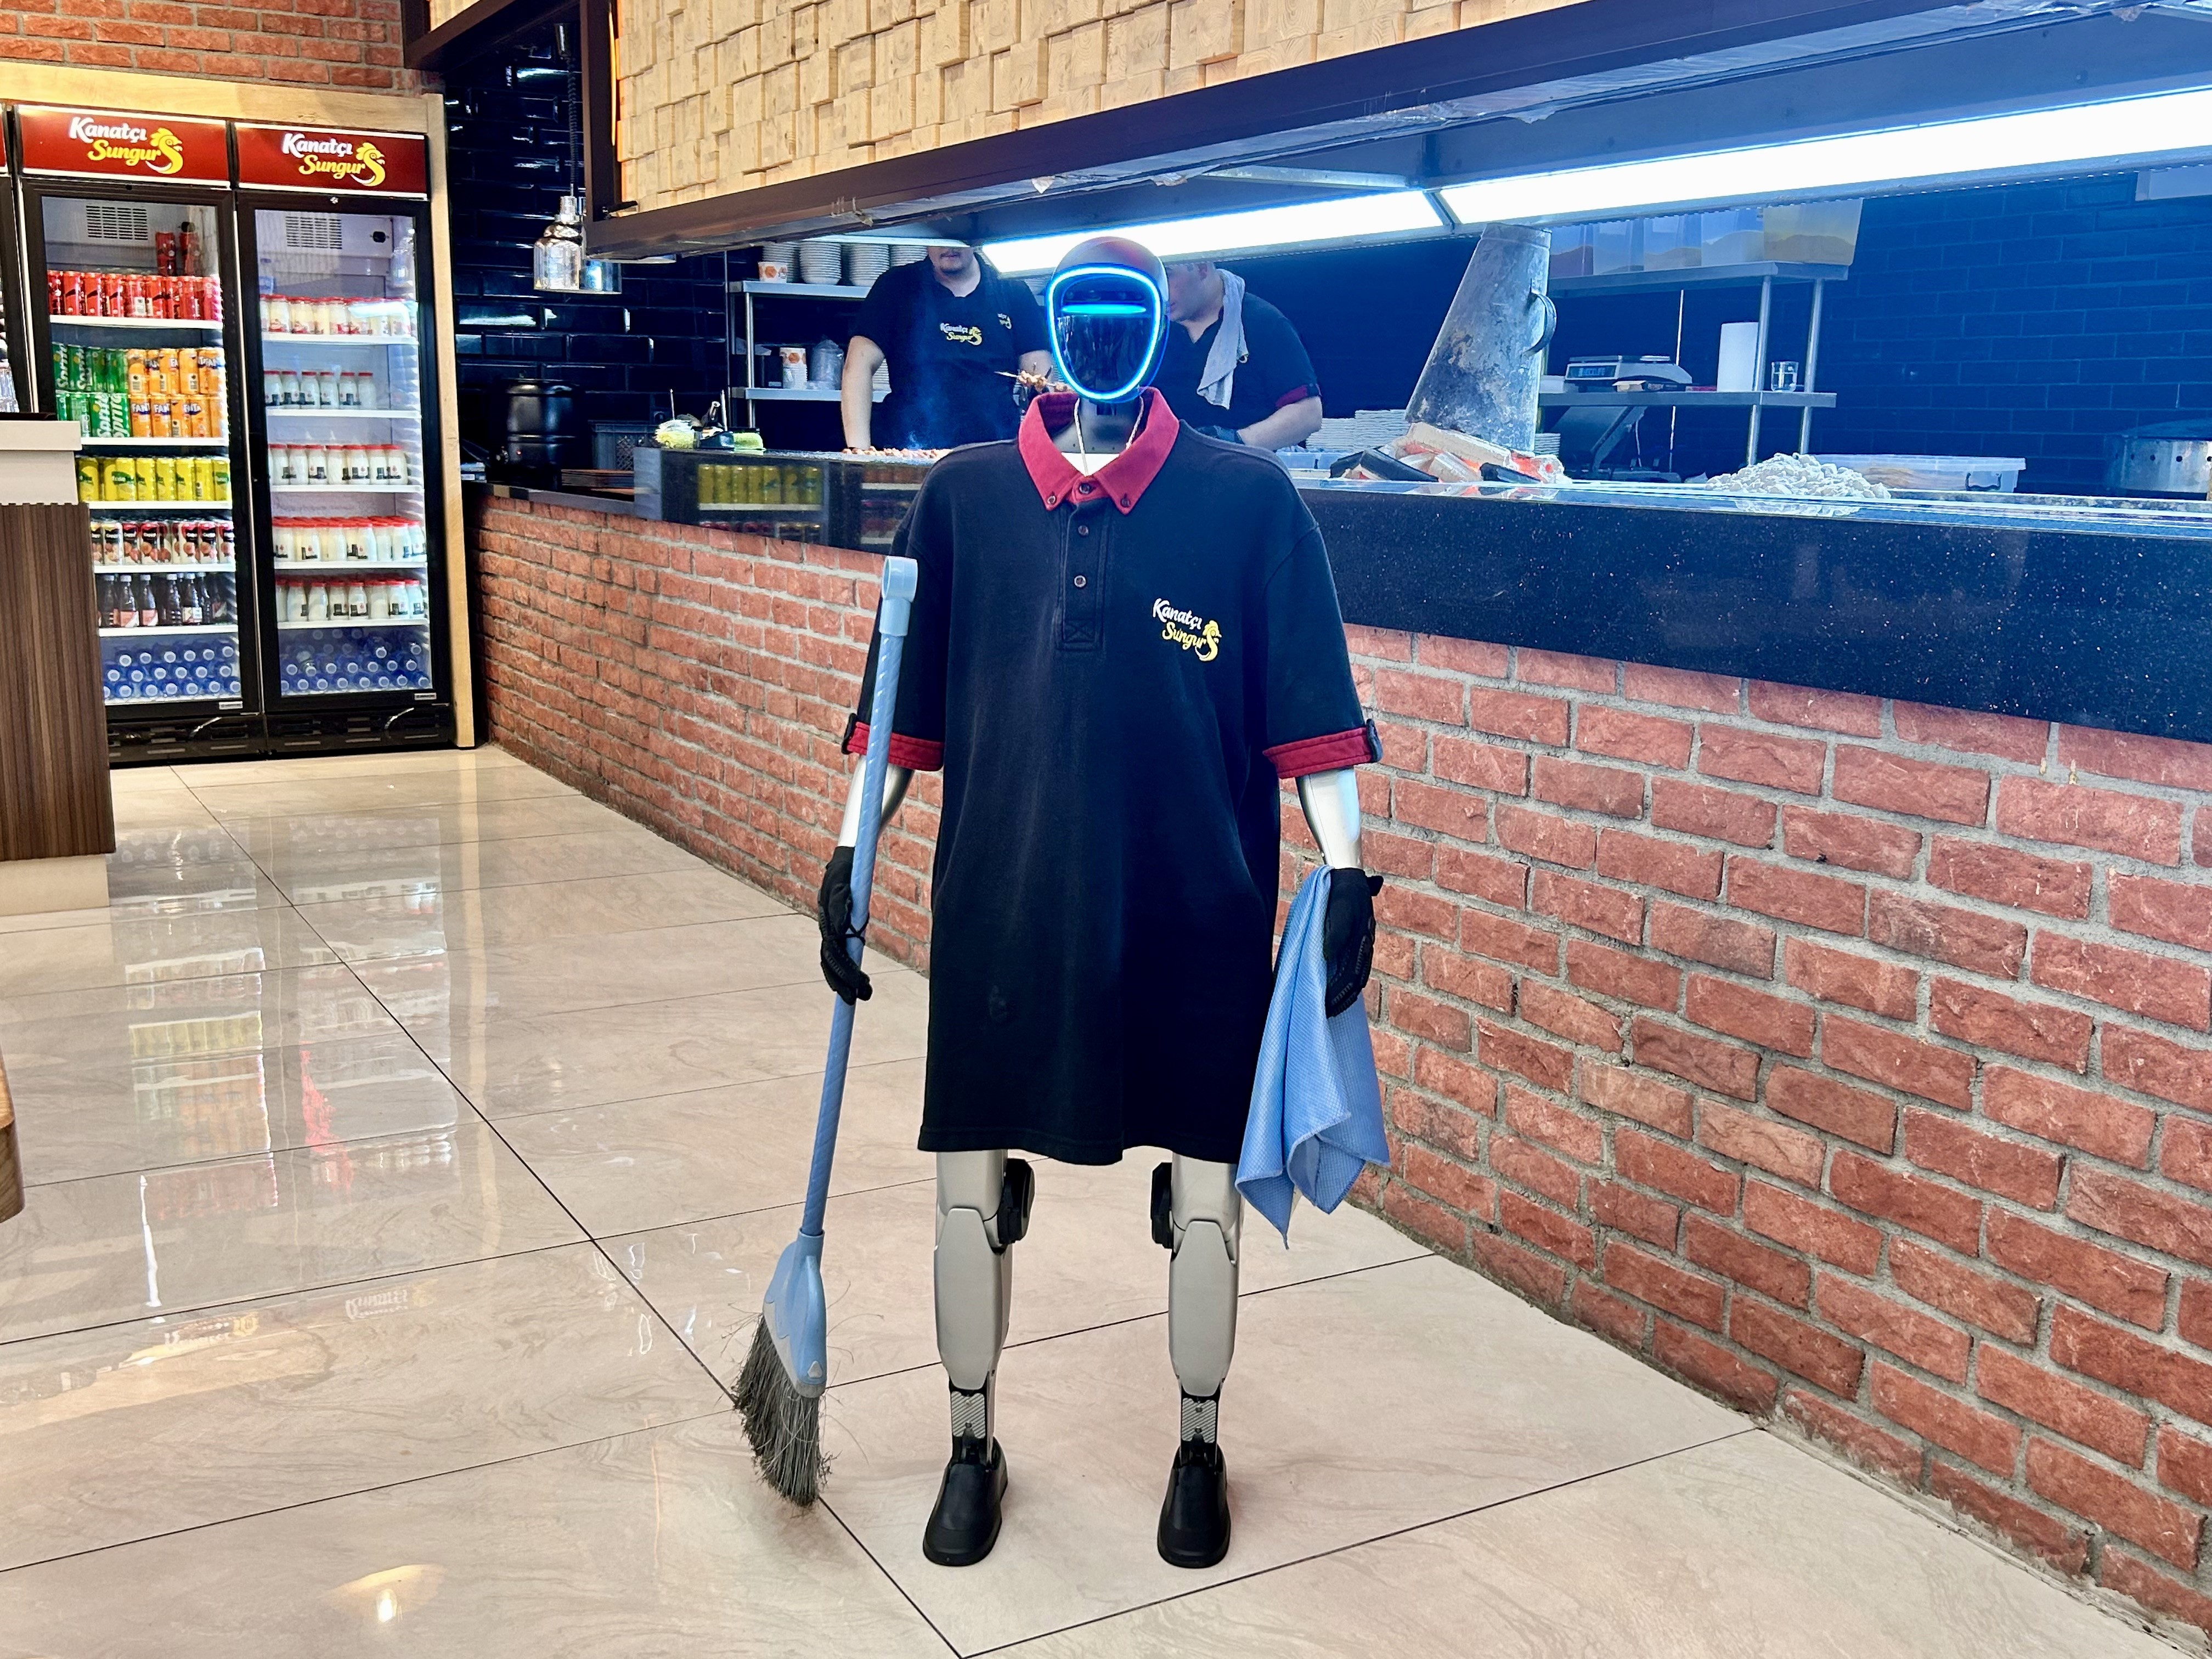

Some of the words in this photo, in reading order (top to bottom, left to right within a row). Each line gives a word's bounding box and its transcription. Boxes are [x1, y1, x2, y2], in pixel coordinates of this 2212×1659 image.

[69, 116, 148, 144] Kanatçı
[282, 133, 353, 159] Kanatçı
[1152, 597, 1203, 630] Kanatçı
[1161, 621, 1207, 650] Sungur
